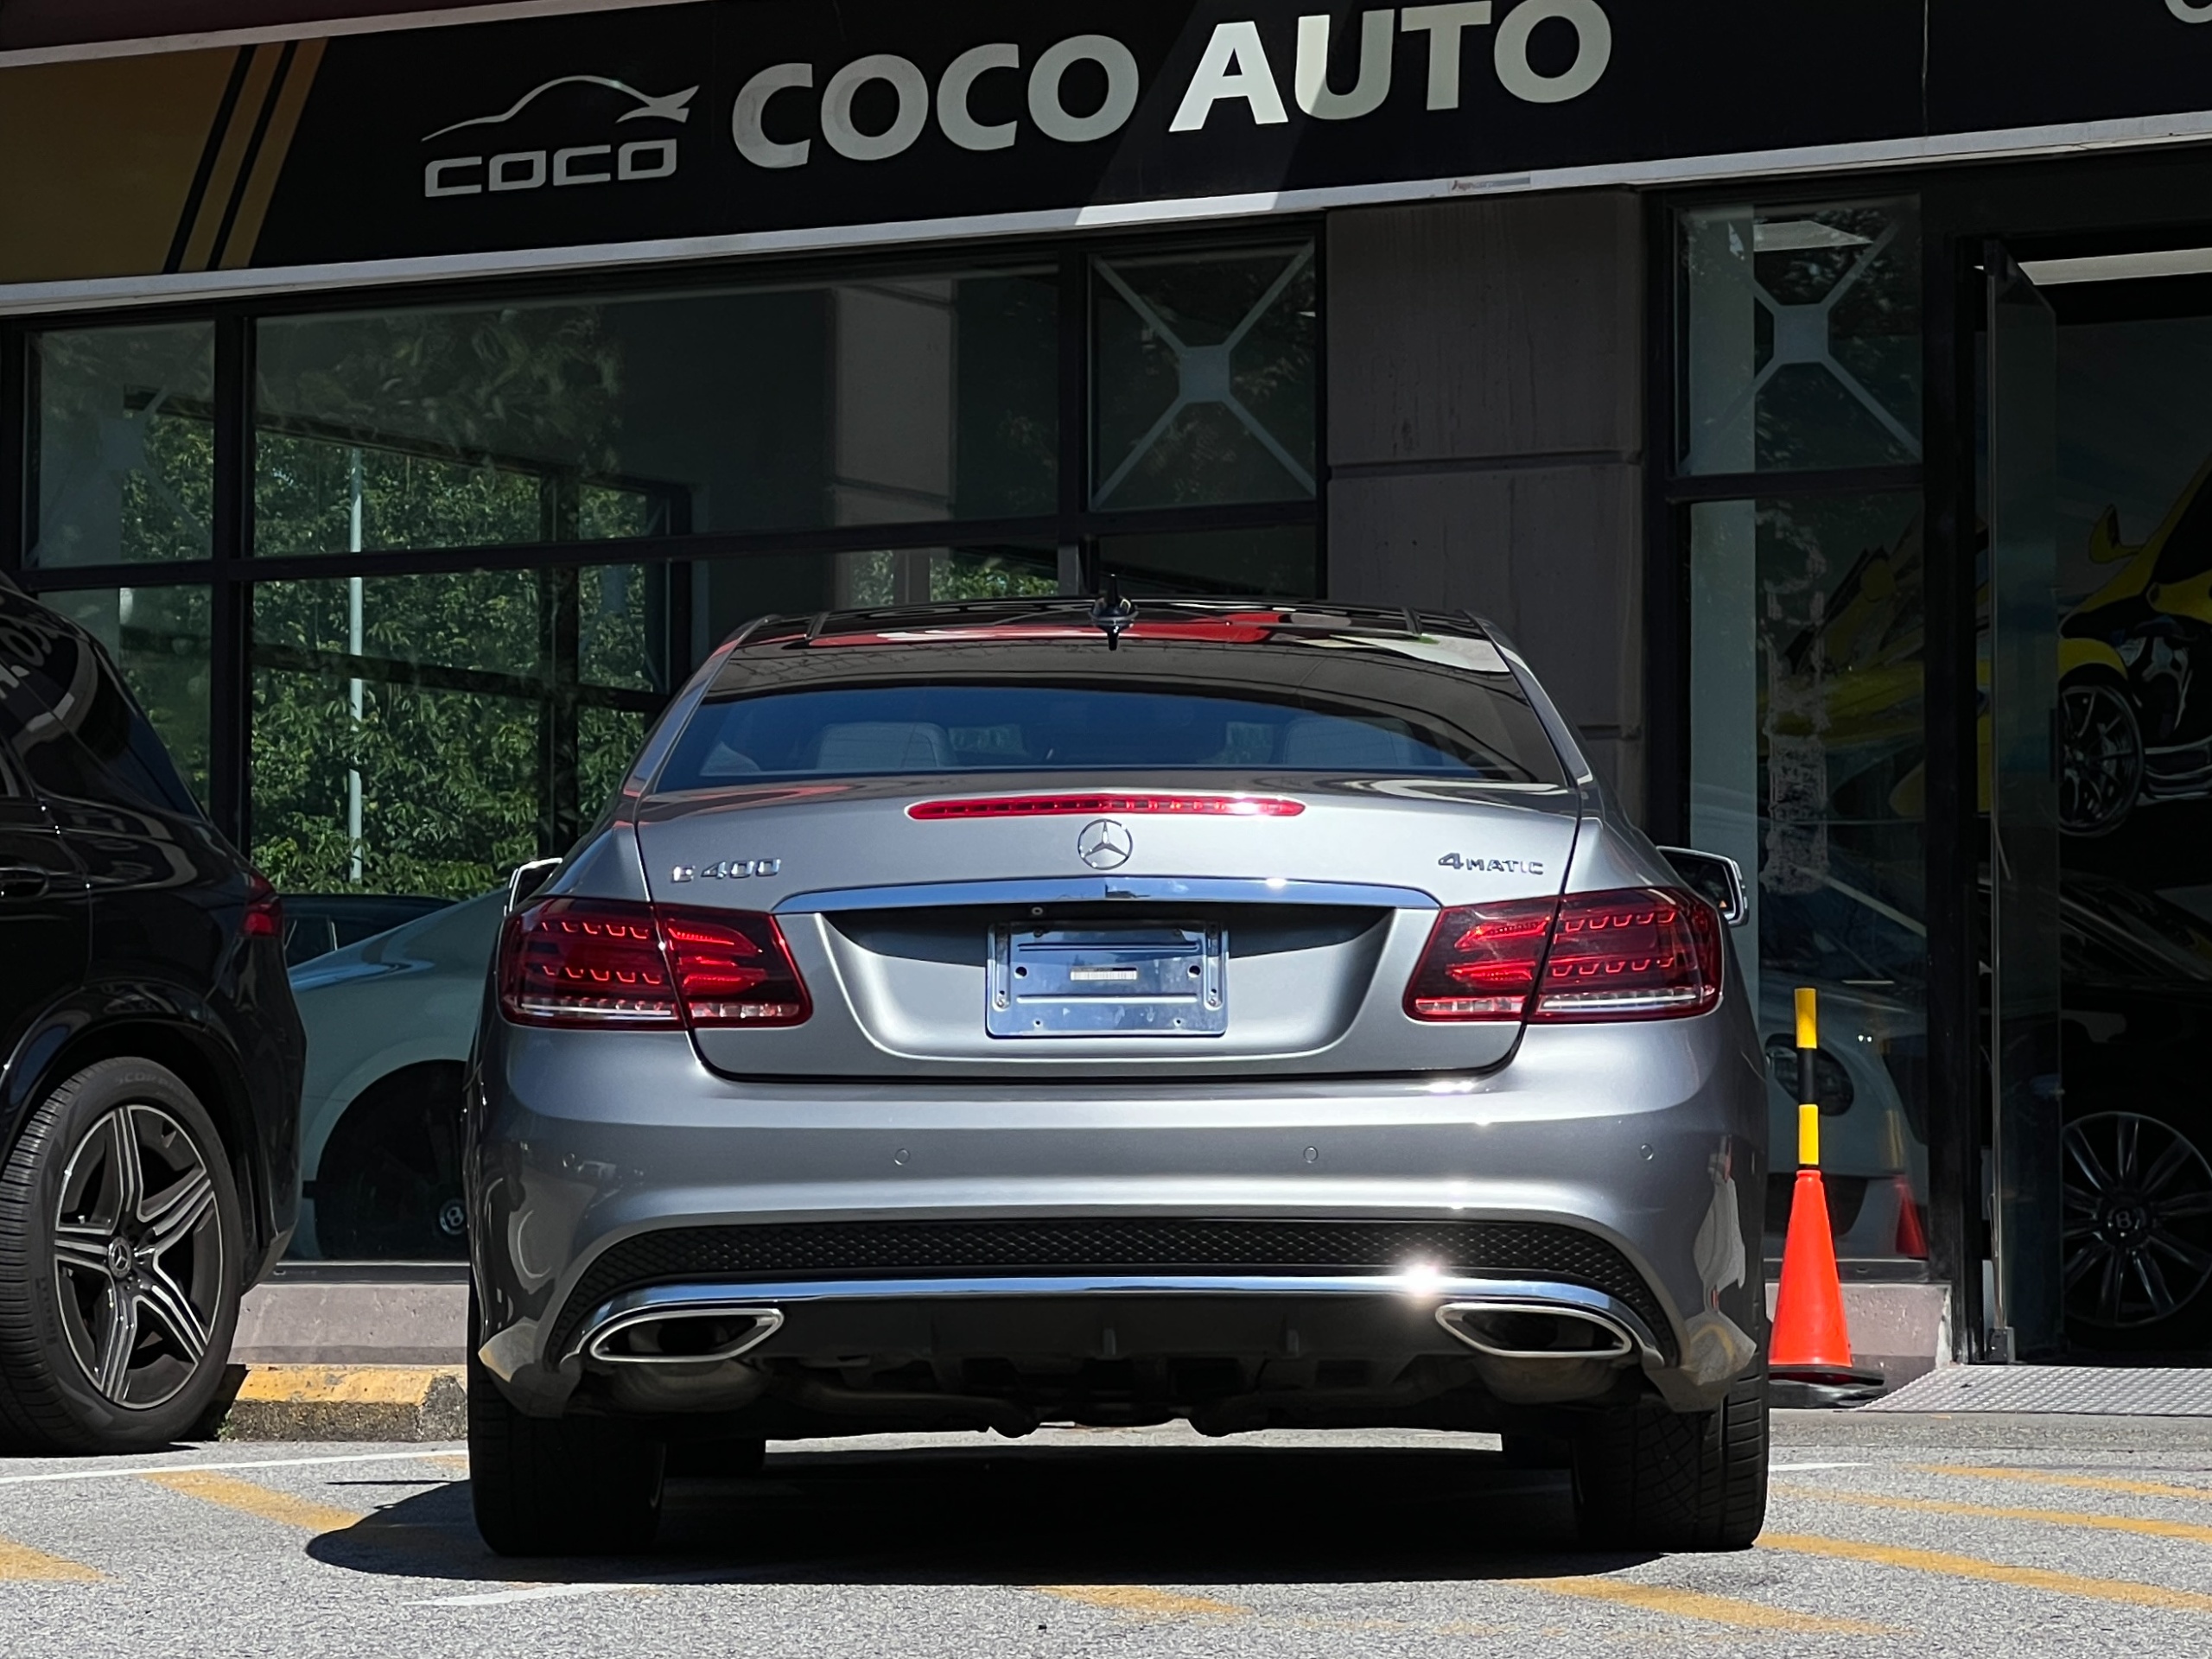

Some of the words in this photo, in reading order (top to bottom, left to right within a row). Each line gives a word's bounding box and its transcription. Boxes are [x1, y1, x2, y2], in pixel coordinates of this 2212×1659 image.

[733, 34, 1140, 168] COCO
[1169, 0, 1612, 133] AUTO
[424, 138, 677, 198] COCO
[1438, 852, 1544, 875] 4MATIC
